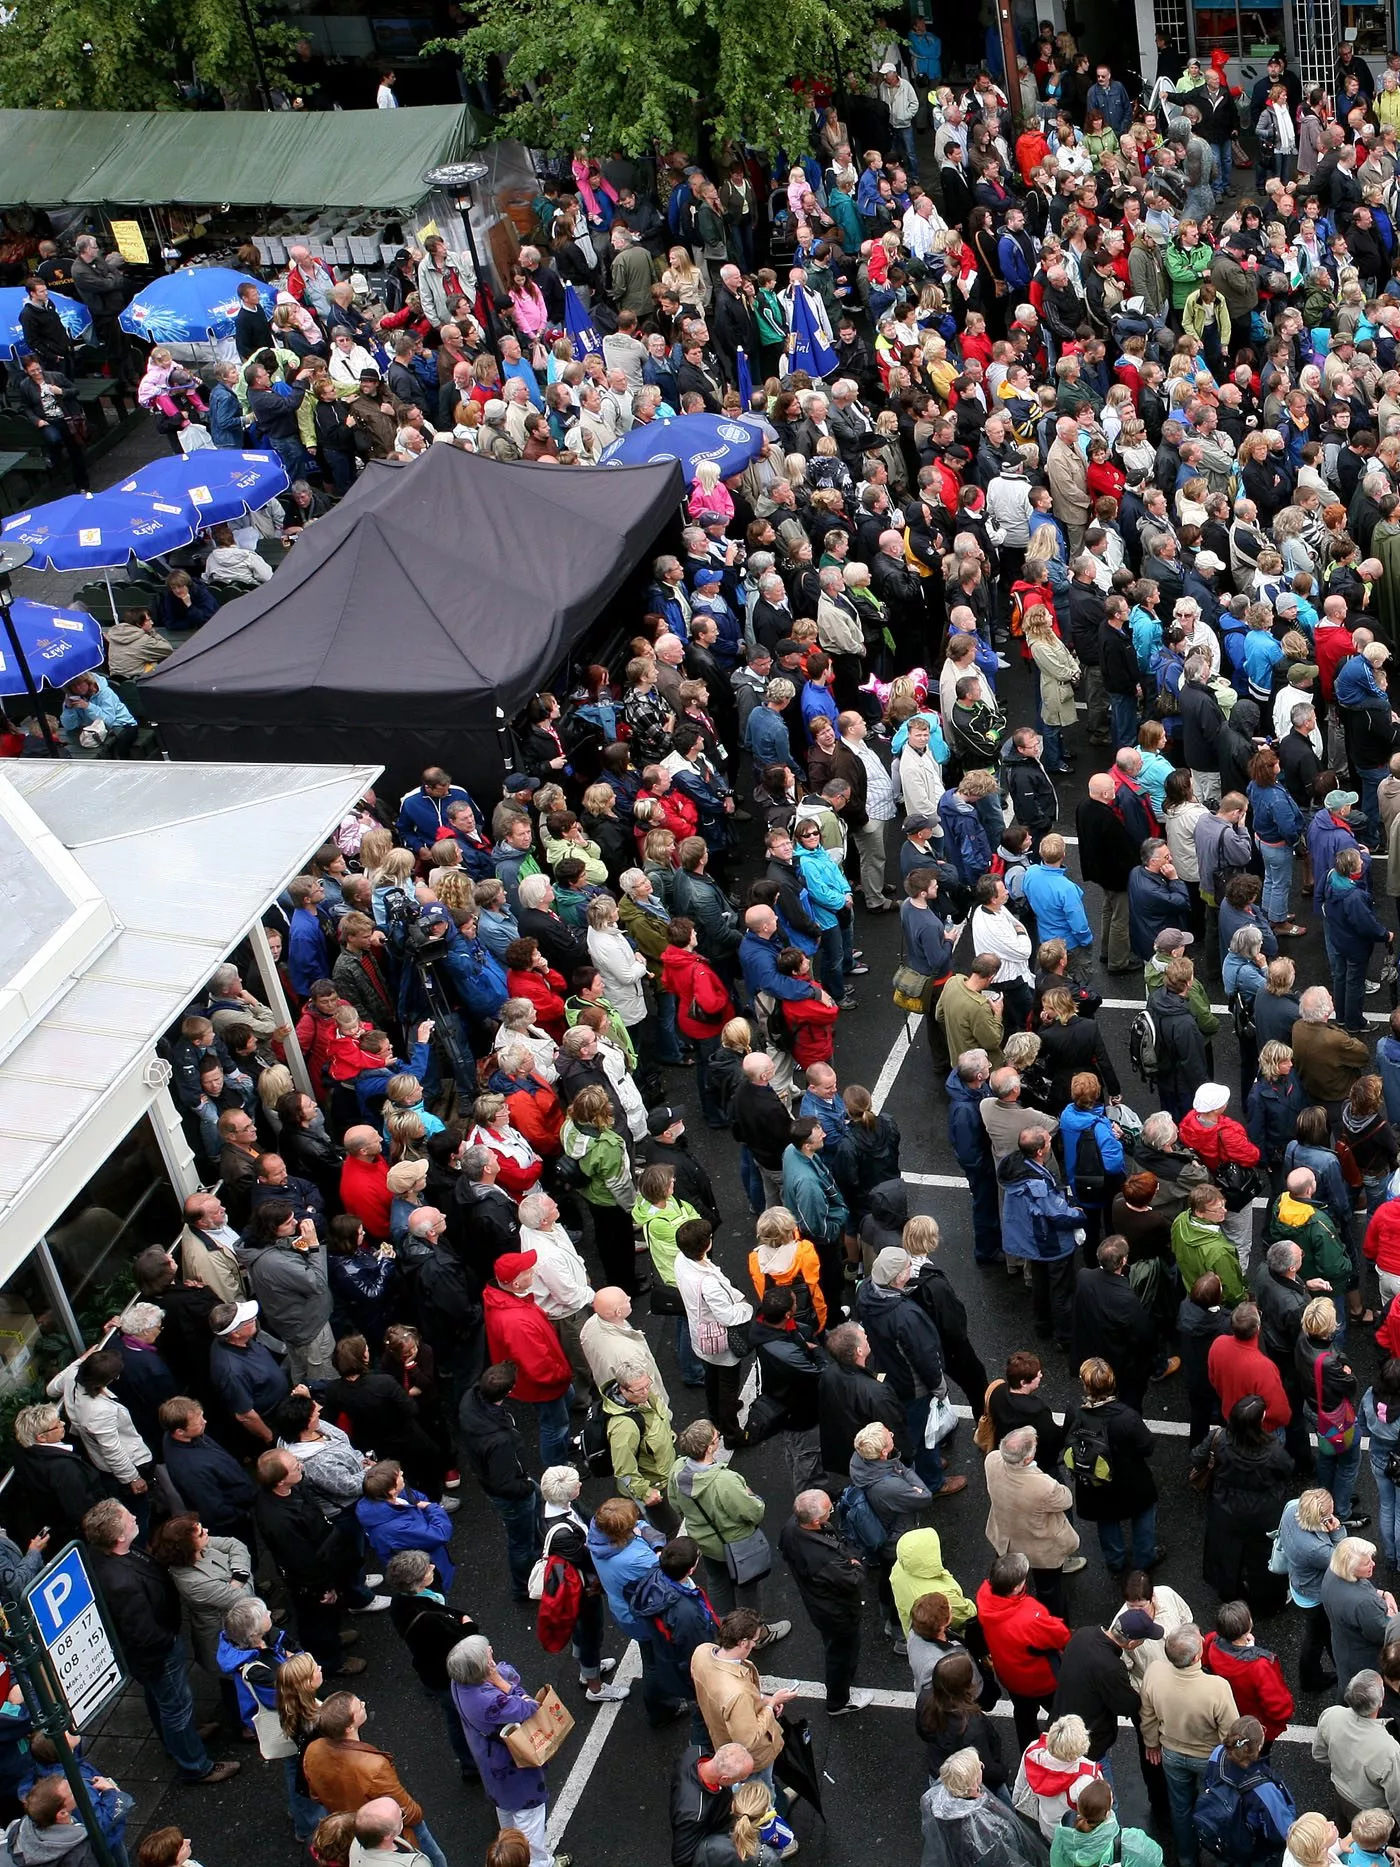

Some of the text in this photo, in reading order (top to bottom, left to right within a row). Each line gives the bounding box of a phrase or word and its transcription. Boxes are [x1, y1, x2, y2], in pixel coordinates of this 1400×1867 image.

[43, 1572, 73, 1629] P
[57, 1635, 73, 1656] 08
[81, 1612, 92, 1630] 17
[59, 1653, 80, 1680] (08
[87, 1626, 104, 1648] 15)
[65, 1644, 108, 1692] Maks 3 timer
[73, 1657, 107, 1696] mot avgift
